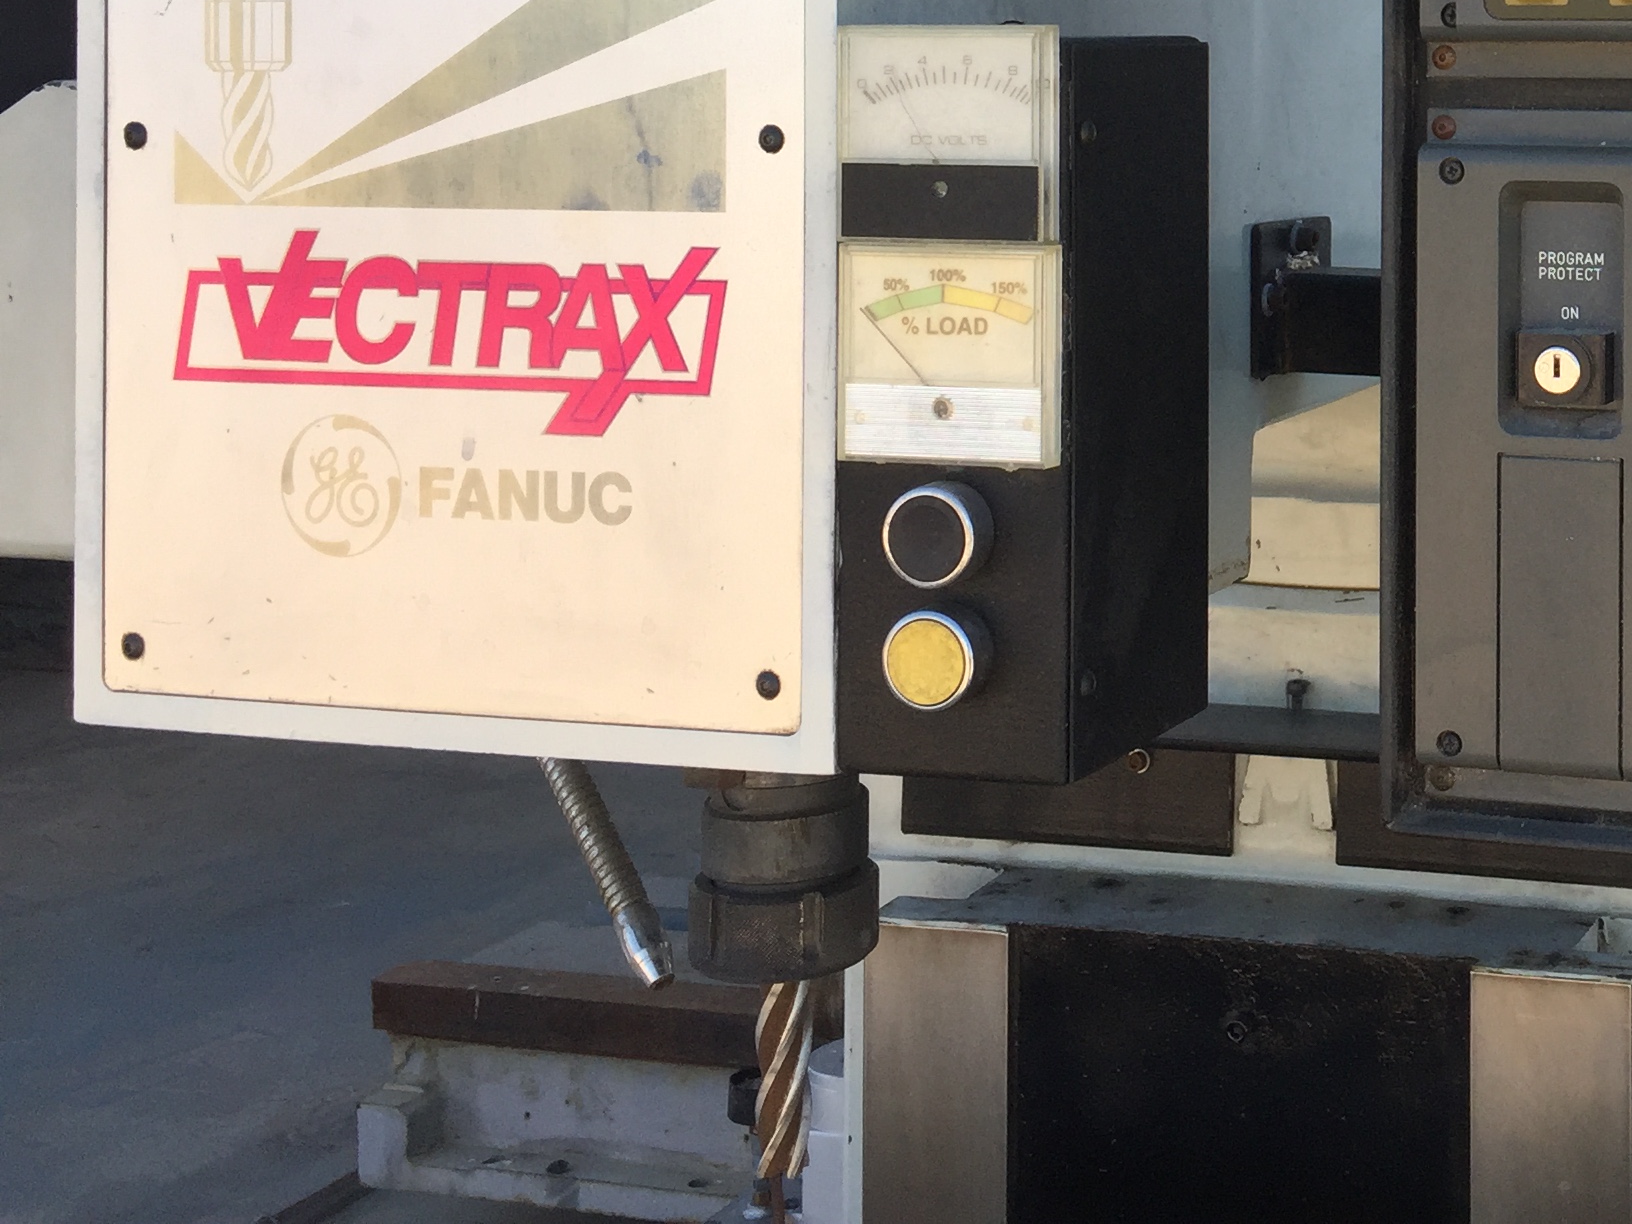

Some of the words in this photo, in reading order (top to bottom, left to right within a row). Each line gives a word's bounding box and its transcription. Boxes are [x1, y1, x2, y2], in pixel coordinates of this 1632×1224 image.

[1537, 250, 1605, 266] PROGRAM
[929, 269, 967, 283] 100%
[1537, 266, 1603, 282] PROTECT
[882, 278, 910, 292] 50%
[991, 281, 1028, 296] 150%
[1560, 305, 1580, 320] ON
[200, 227, 724, 437] VECTRAX
[901, 315, 920, 336] %
[925, 317, 989, 336] LOAD
[418, 466, 634, 527] FANUC
